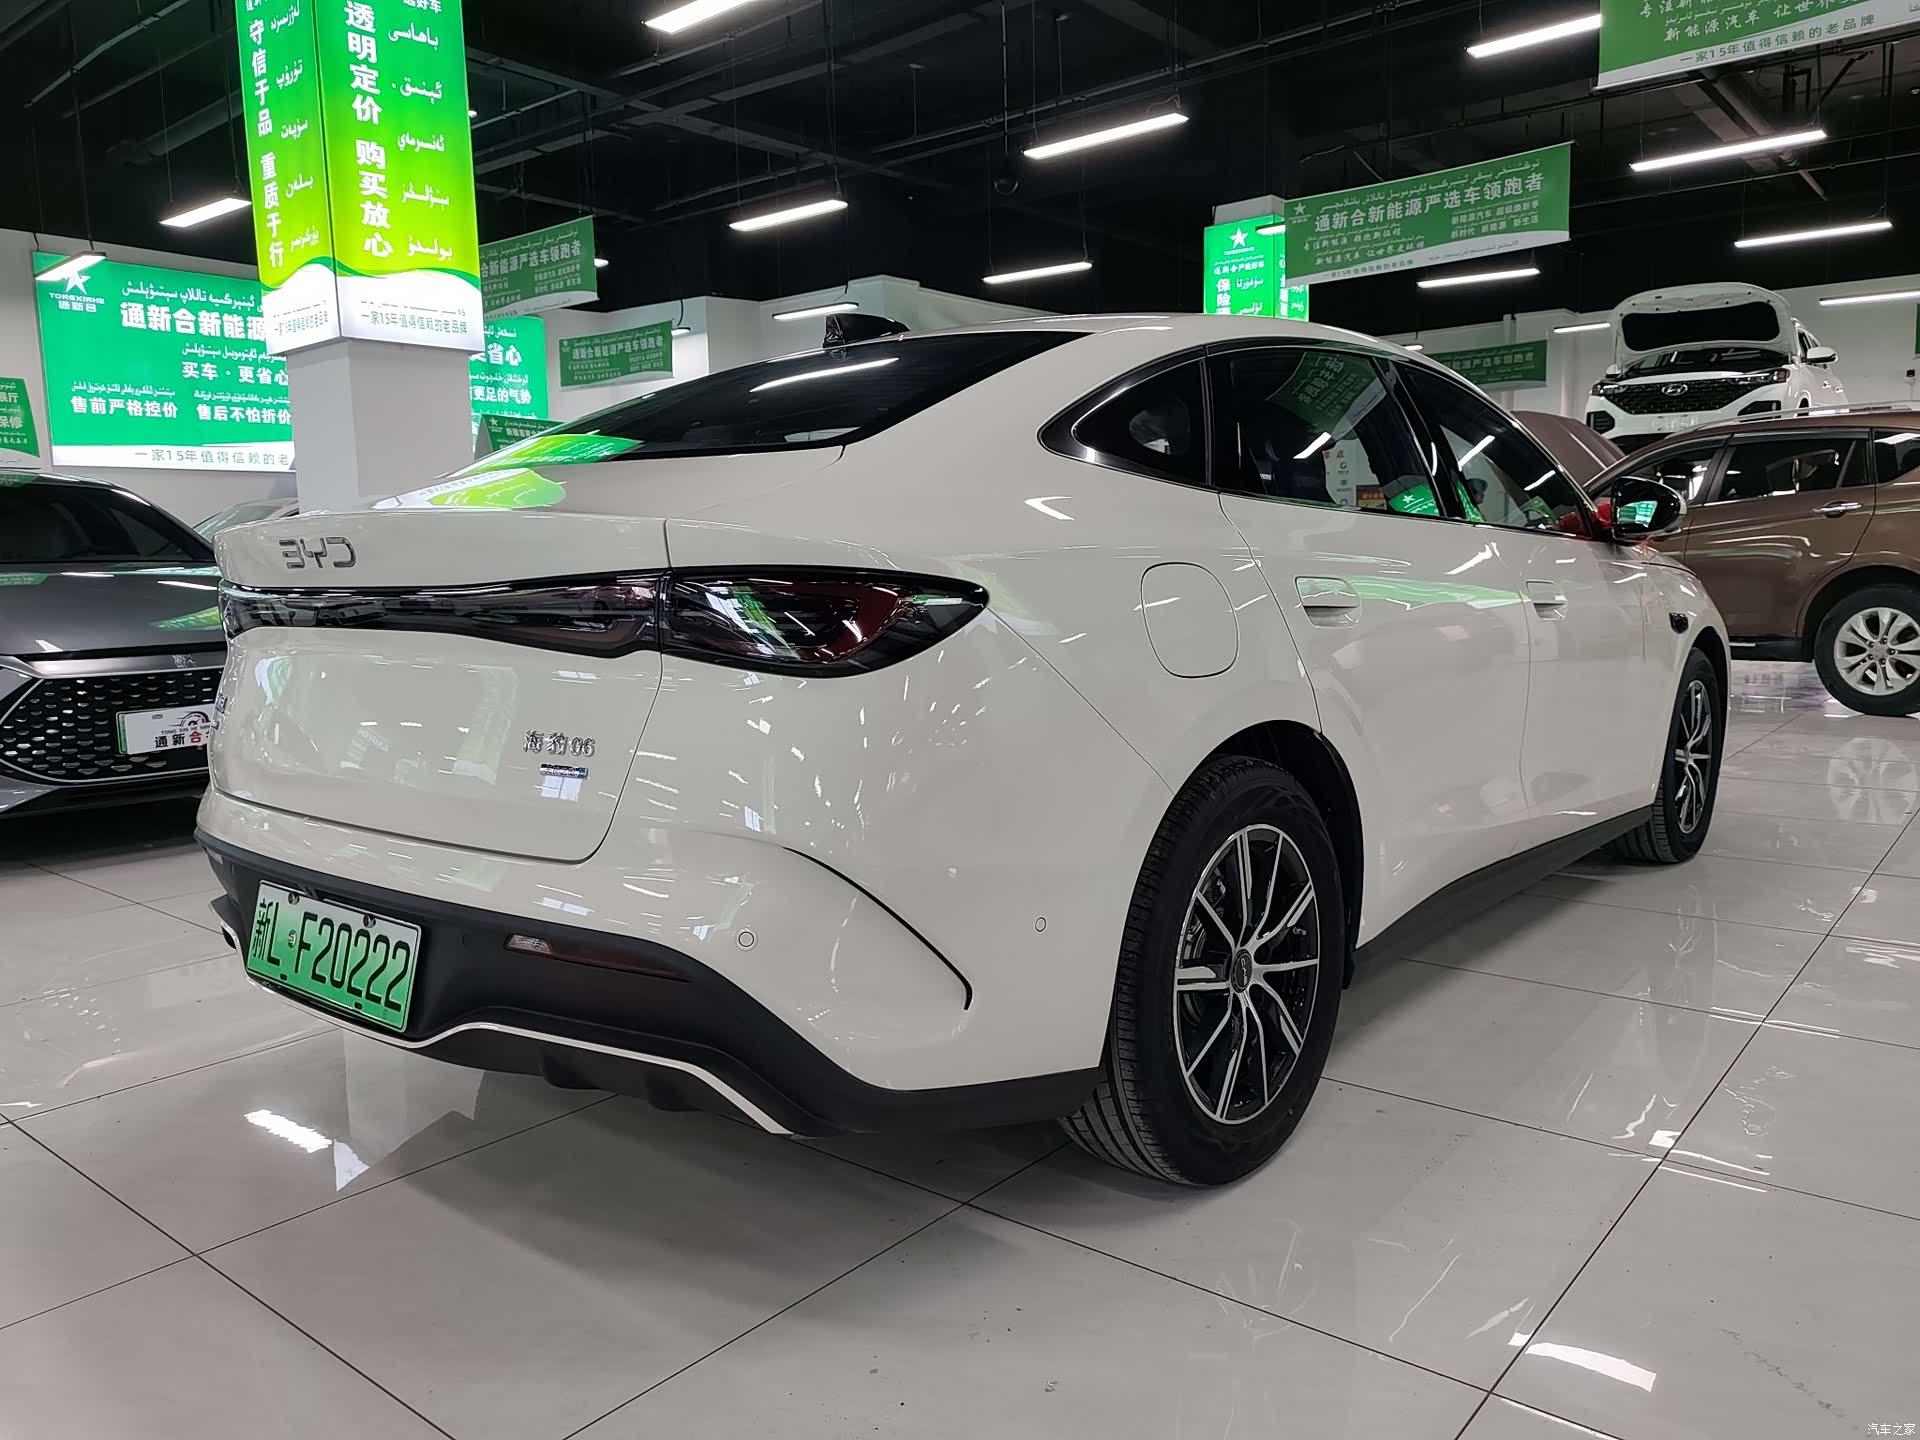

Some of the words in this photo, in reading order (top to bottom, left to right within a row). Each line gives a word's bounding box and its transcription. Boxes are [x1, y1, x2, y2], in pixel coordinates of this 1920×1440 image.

[1664, 8, 1760, 42] 新能源汽车
[1680, 14, 1876, 62] 一家15年值得信赖的老品牌
[344, 0, 383, 125] 透明定价
[249, 19, 273, 137] 守信于品
[261, 151, 284, 268] 重质于行
[356, 139, 394, 258] 购买放心
[1315, 172, 1544, 232] 通新合新能源严选车领跑者
[120, 301, 267, 341] 通新合新能源
[70, 395, 179, 419] 售前严格控价
[196, 403, 292, 425] 售后不怕折价
[279, 536, 356, 569] BYD
